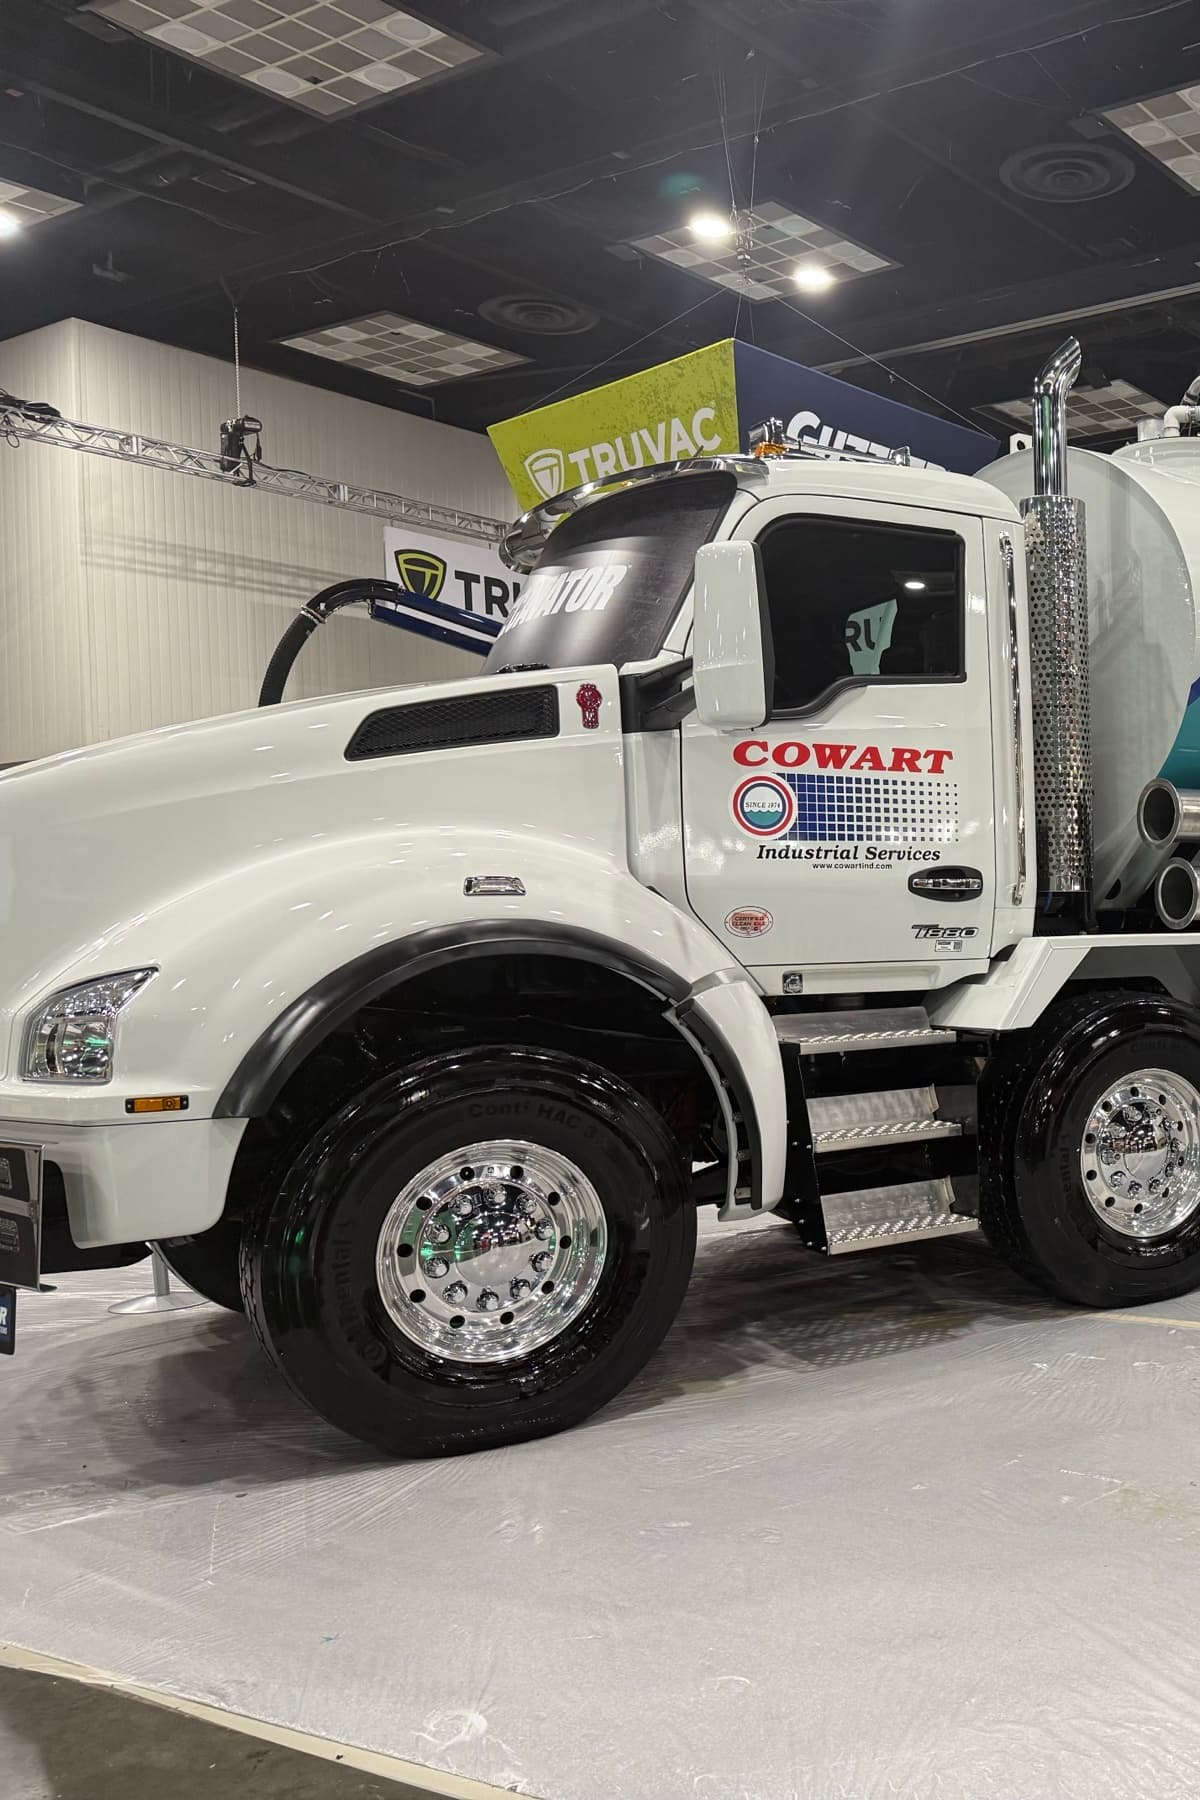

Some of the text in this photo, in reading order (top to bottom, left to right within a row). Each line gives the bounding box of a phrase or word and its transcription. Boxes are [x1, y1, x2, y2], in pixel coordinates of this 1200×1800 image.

[568, 407, 722, 484] TRUVAC
[733, 740, 953, 774] COWART
[745, 801, 767, 809] SINCE
[756, 845, 941, 861] Industrial Services
[812, 862, 893, 870] www.cowartind.com
[911, 924, 979, 939] T880
